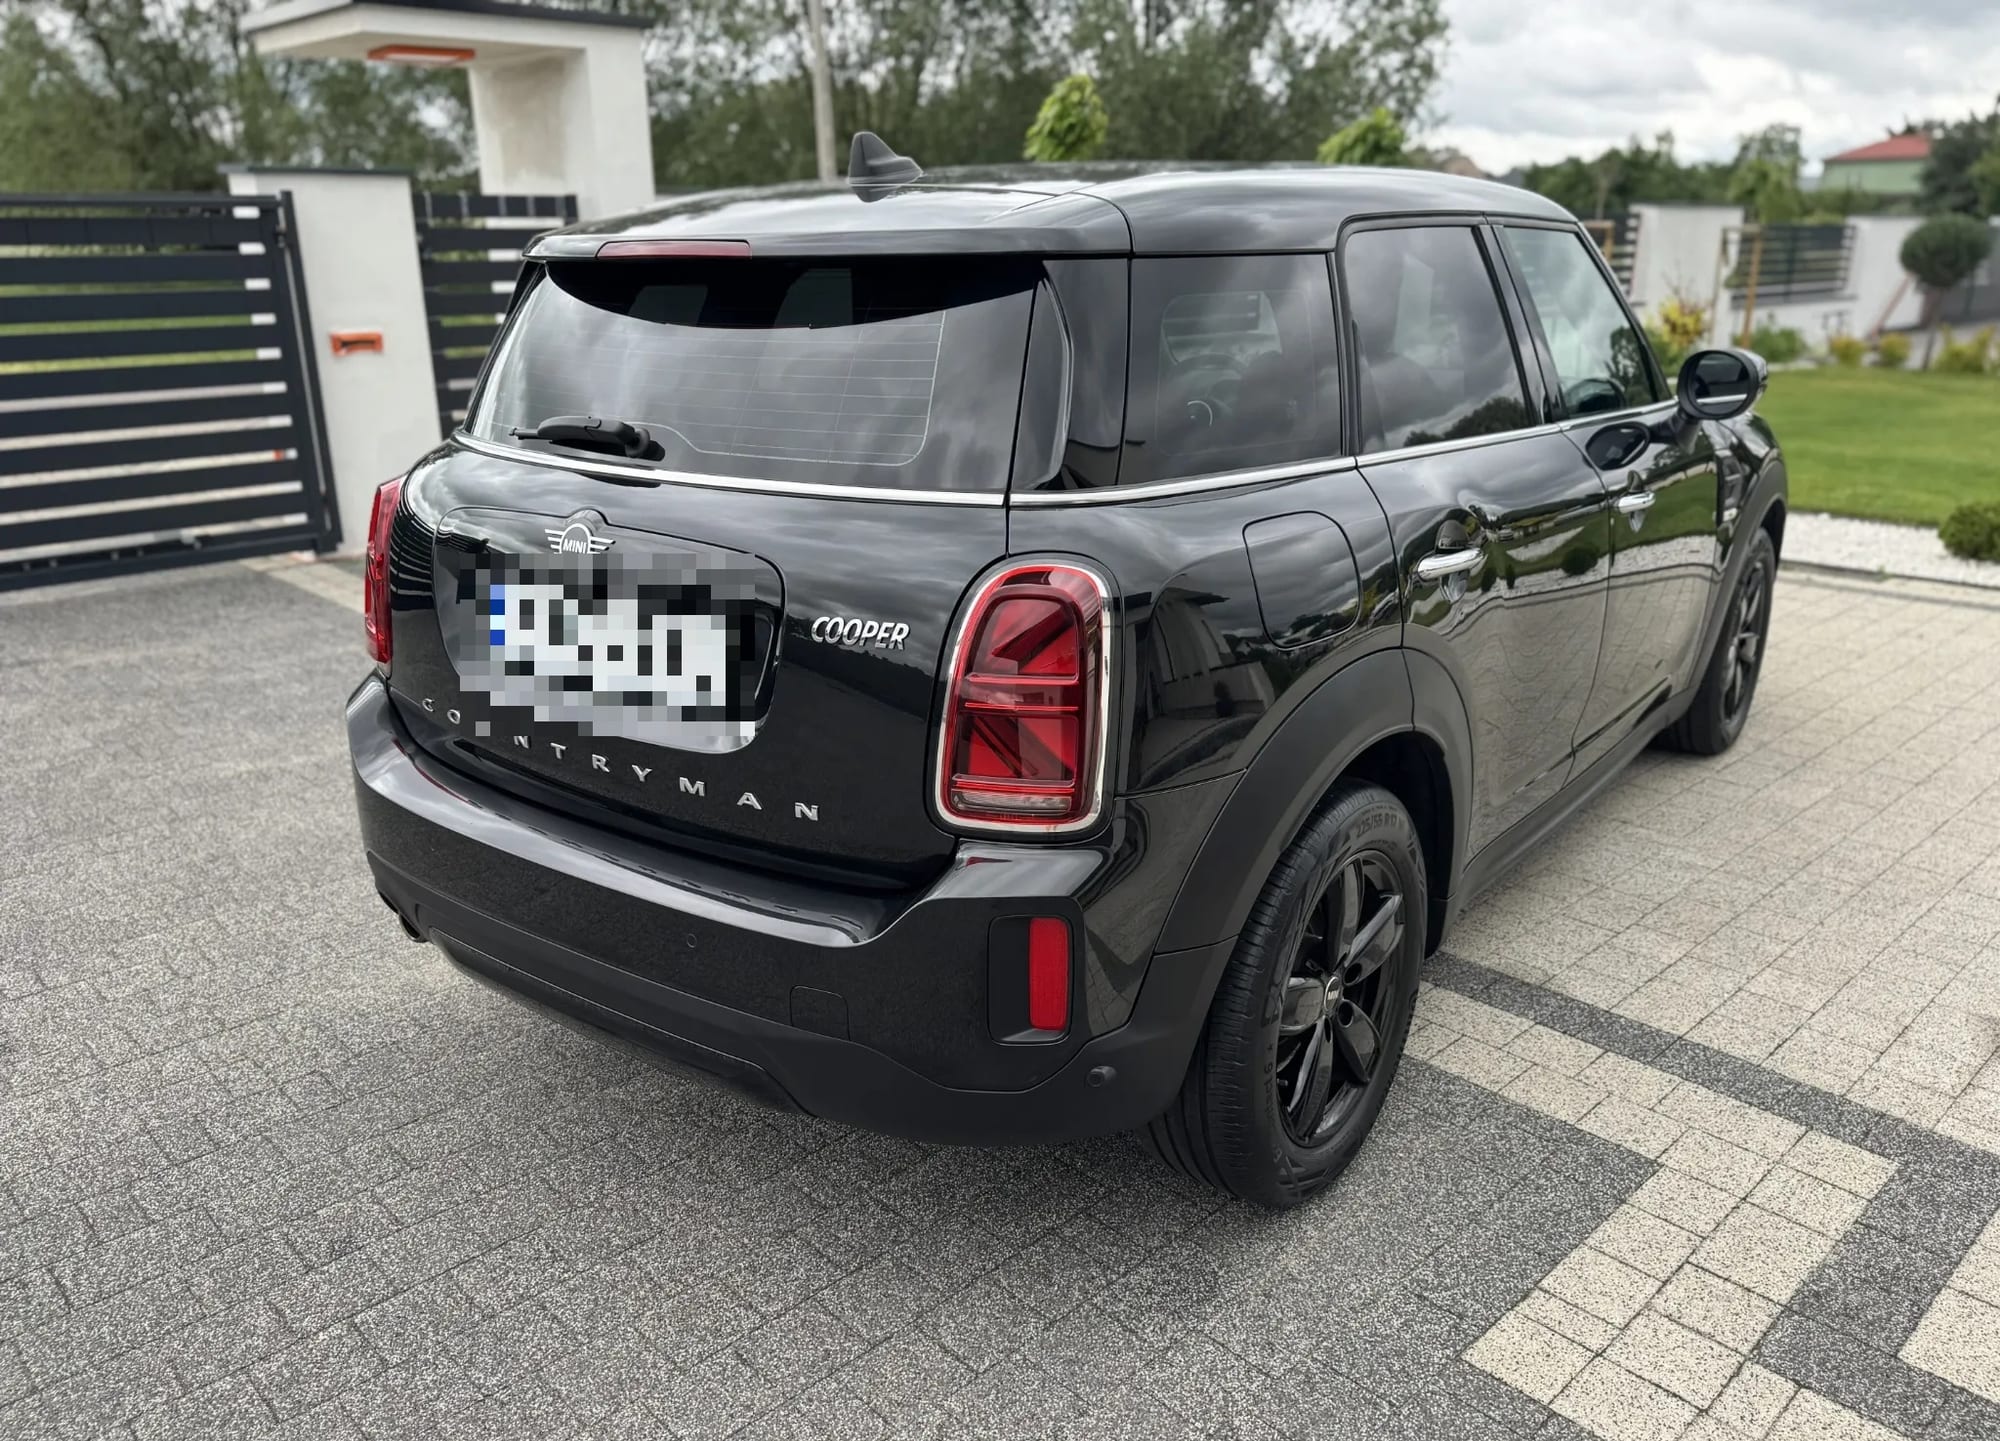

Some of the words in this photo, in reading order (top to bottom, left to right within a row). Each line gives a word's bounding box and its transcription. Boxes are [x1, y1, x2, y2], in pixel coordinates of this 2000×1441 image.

[563, 538, 587, 554] MINI
[811, 616, 910, 650] COOPER
[422, 698, 819, 821] CONTRYMAN
